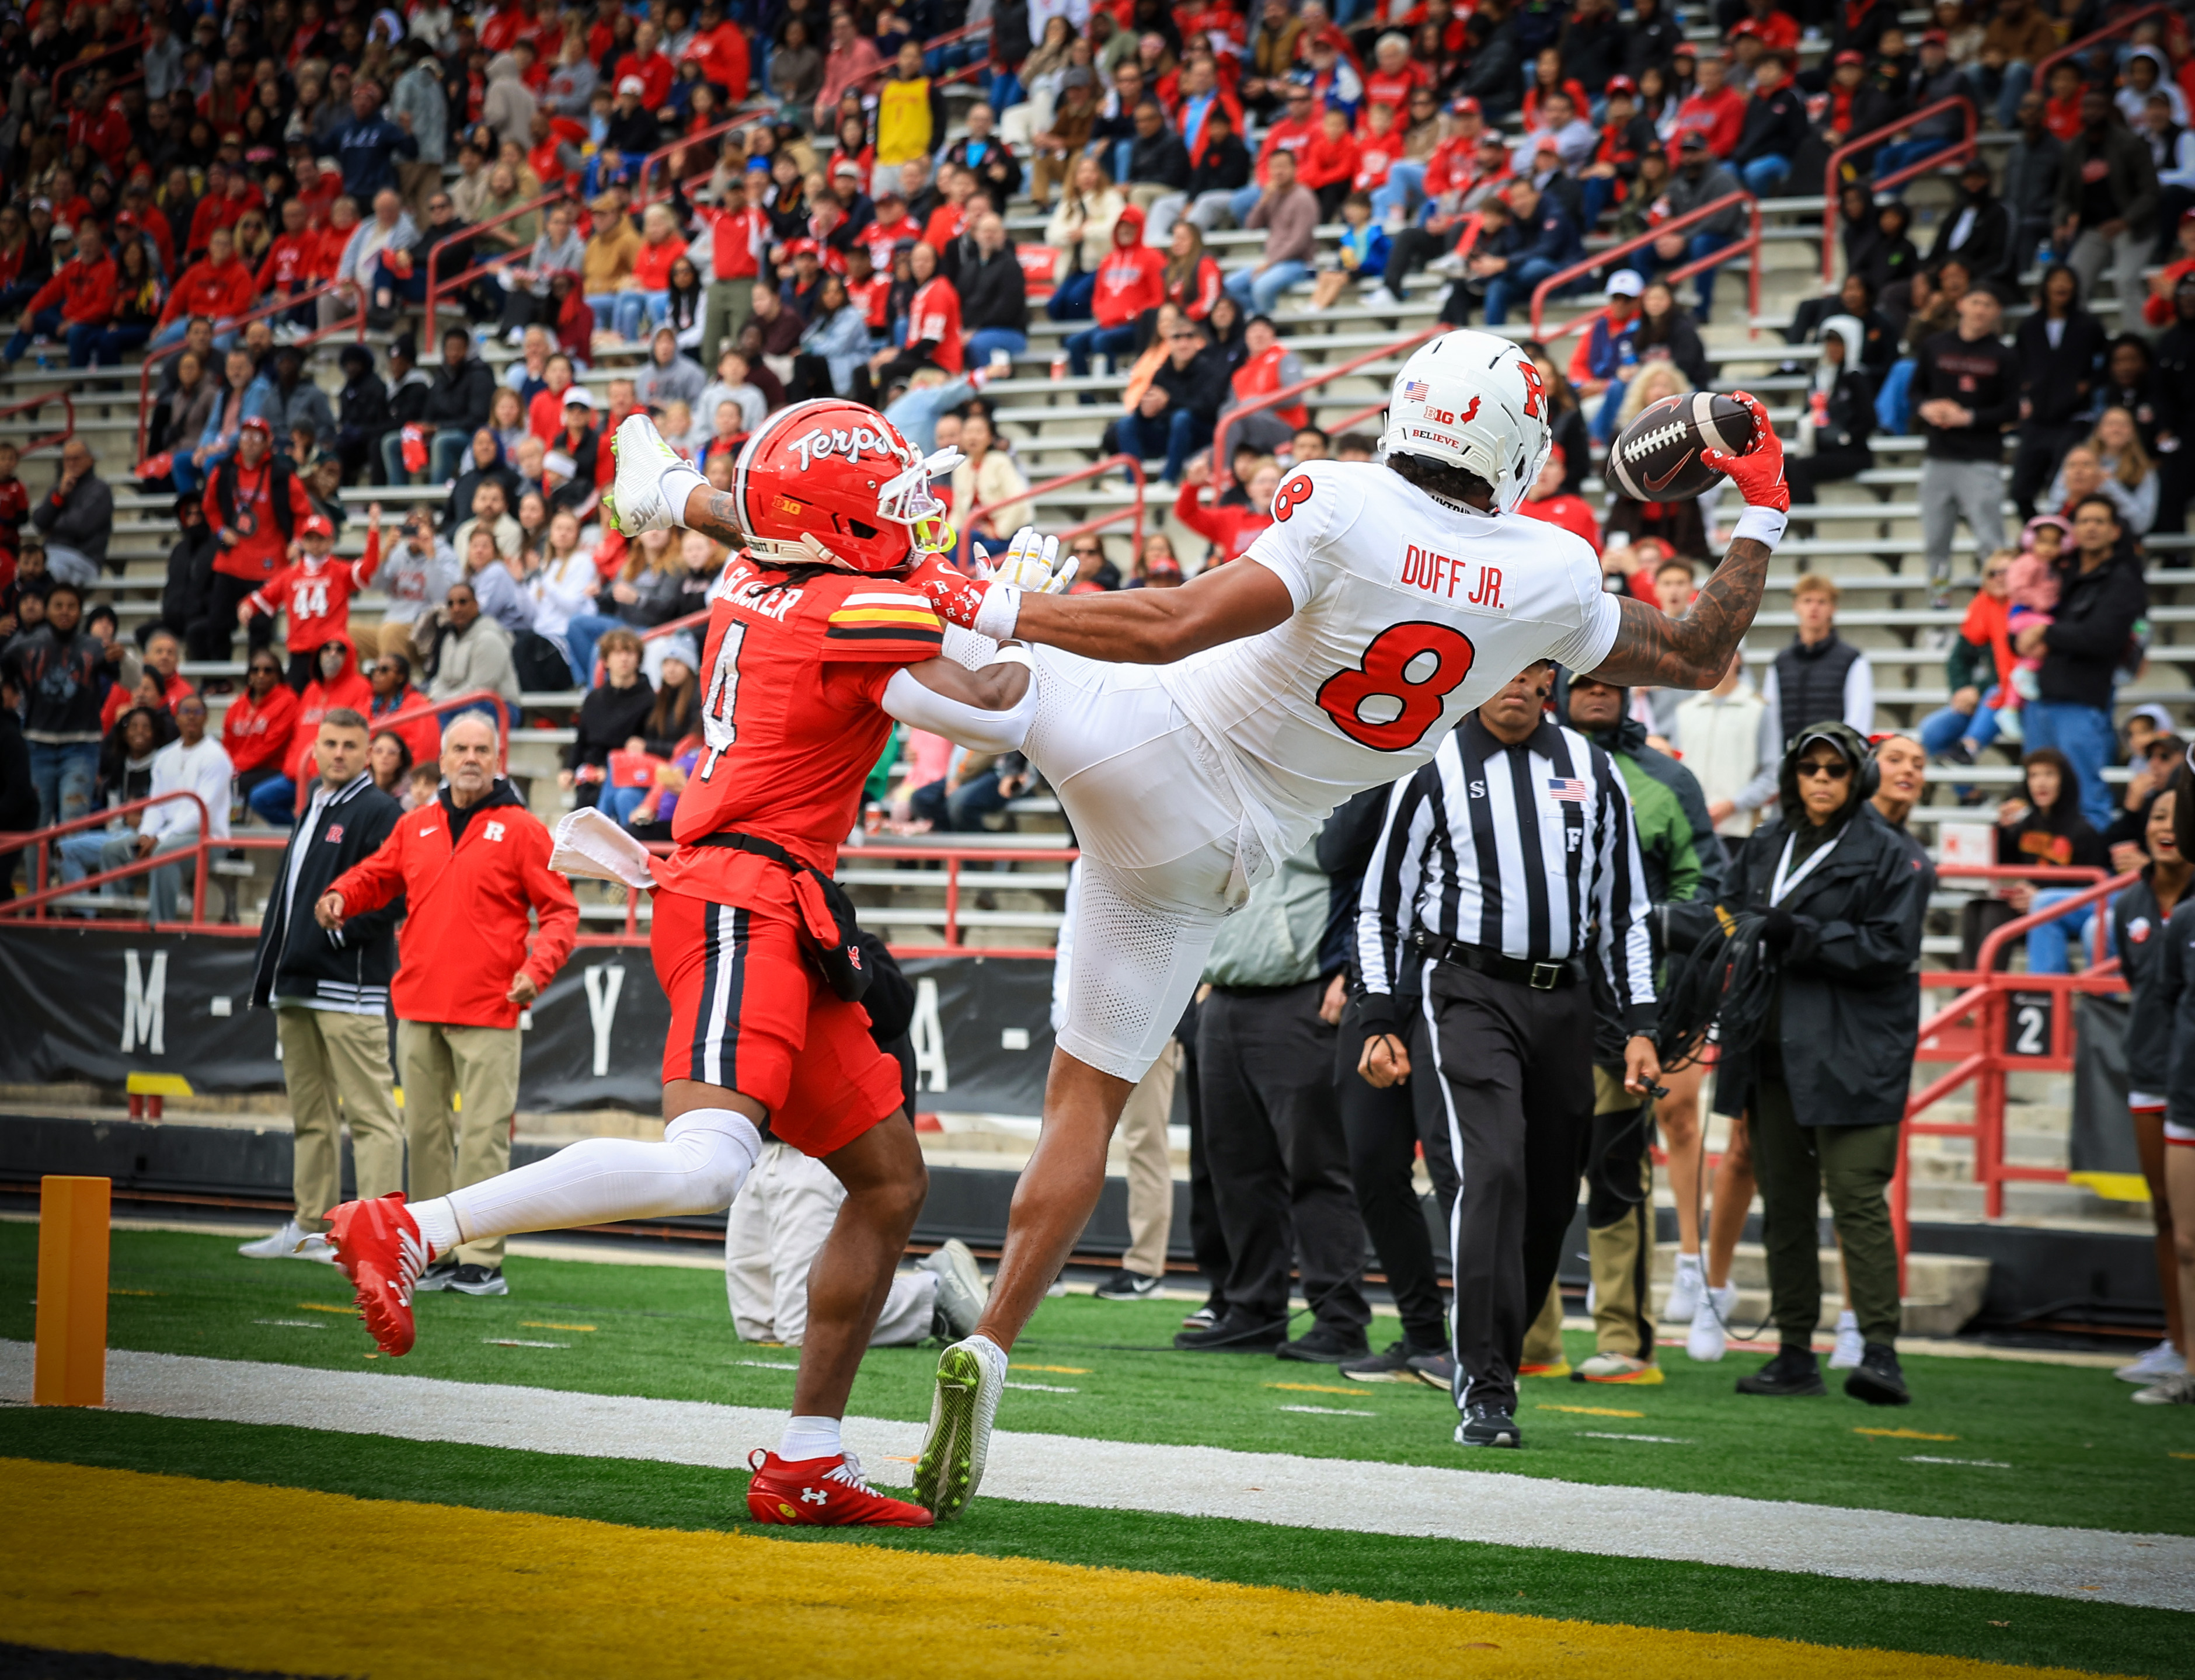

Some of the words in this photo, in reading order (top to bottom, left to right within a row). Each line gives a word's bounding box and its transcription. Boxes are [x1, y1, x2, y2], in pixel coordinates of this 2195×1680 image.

[1514, 360, 1547, 419] R
[1412, 429, 1459, 449] BELIEVE
[1274, 474, 1313, 522] 8
[933, 580, 950, 595] R
[1401, 544, 1466, 598] DUFF
[1468, 566, 1504, 609] JR.
[292, 585, 329, 621] 44
[945, 607, 957, 617] R
[701, 618, 749, 783] 4
[1315, 621, 1476, 752] 8
[1469, 780, 1486, 799] S
[325, 824, 344, 844] R
[483, 820, 506, 842] R
[1566, 827, 1583, 853] F
[2016, 1005, 2044, 1054] 2
